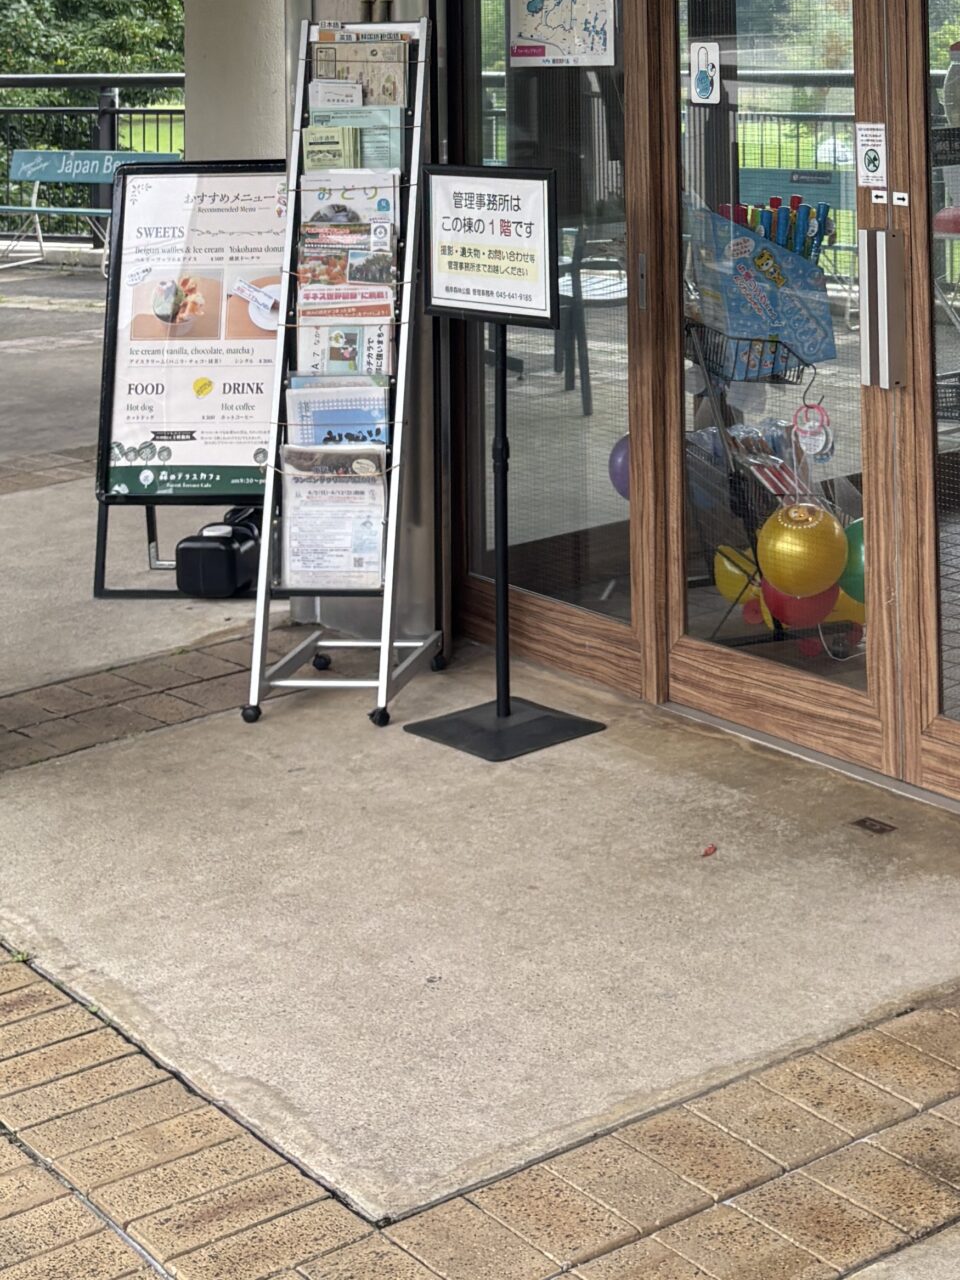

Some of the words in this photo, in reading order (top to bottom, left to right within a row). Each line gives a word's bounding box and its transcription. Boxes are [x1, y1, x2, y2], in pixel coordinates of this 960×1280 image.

[57, 155, 100, 178] Japan
[452, 191, 522, 212] 管理事務所は
[136, 226, 185, 239] SWEETS
[447, 260, 528, 277] 管理事務所までお越しください
[129, 347, 140, 355] Ice
[127, 382, 165, 395] FOOD
[222, 382, 264, 395] DRINK
[126, 403, 139, 411] Hot
[140, 403, 154, 412] dog
[221, 403, 234, 411] Hot
[235, 403, 256, 411] coffee
